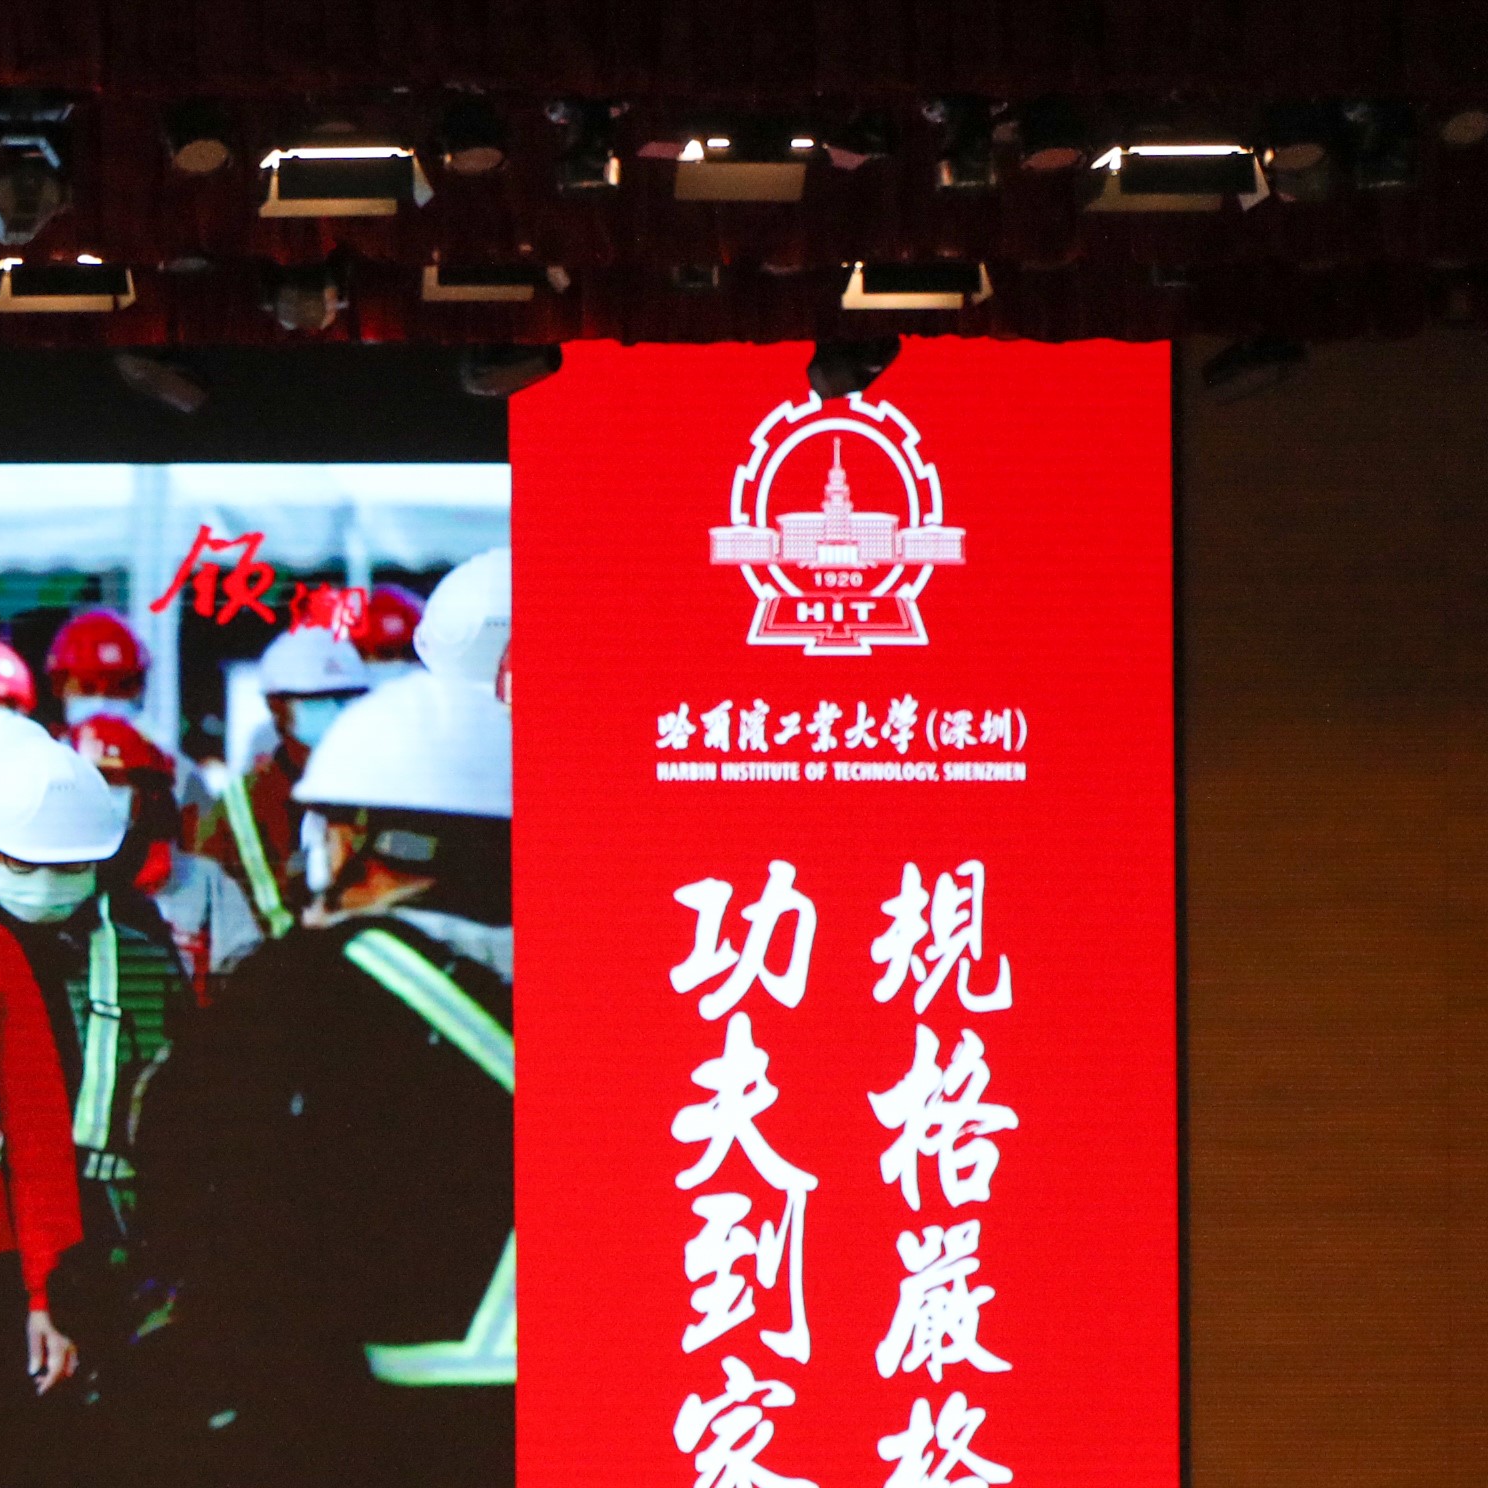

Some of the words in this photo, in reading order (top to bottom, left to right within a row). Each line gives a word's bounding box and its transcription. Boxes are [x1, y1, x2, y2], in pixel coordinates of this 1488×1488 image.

[814, 571, 863, 588] 1920
[796, 601, 877, 623] HIT
[656, 761, 717, 782] HARBIN
[720, 761, 800, 782] INSTITUTE
[804, 761, 827, 782] OF
[833, 761, 940, 784] TECHNOLOGY,
[942, 761, 1027, 782] SHENZHEN
